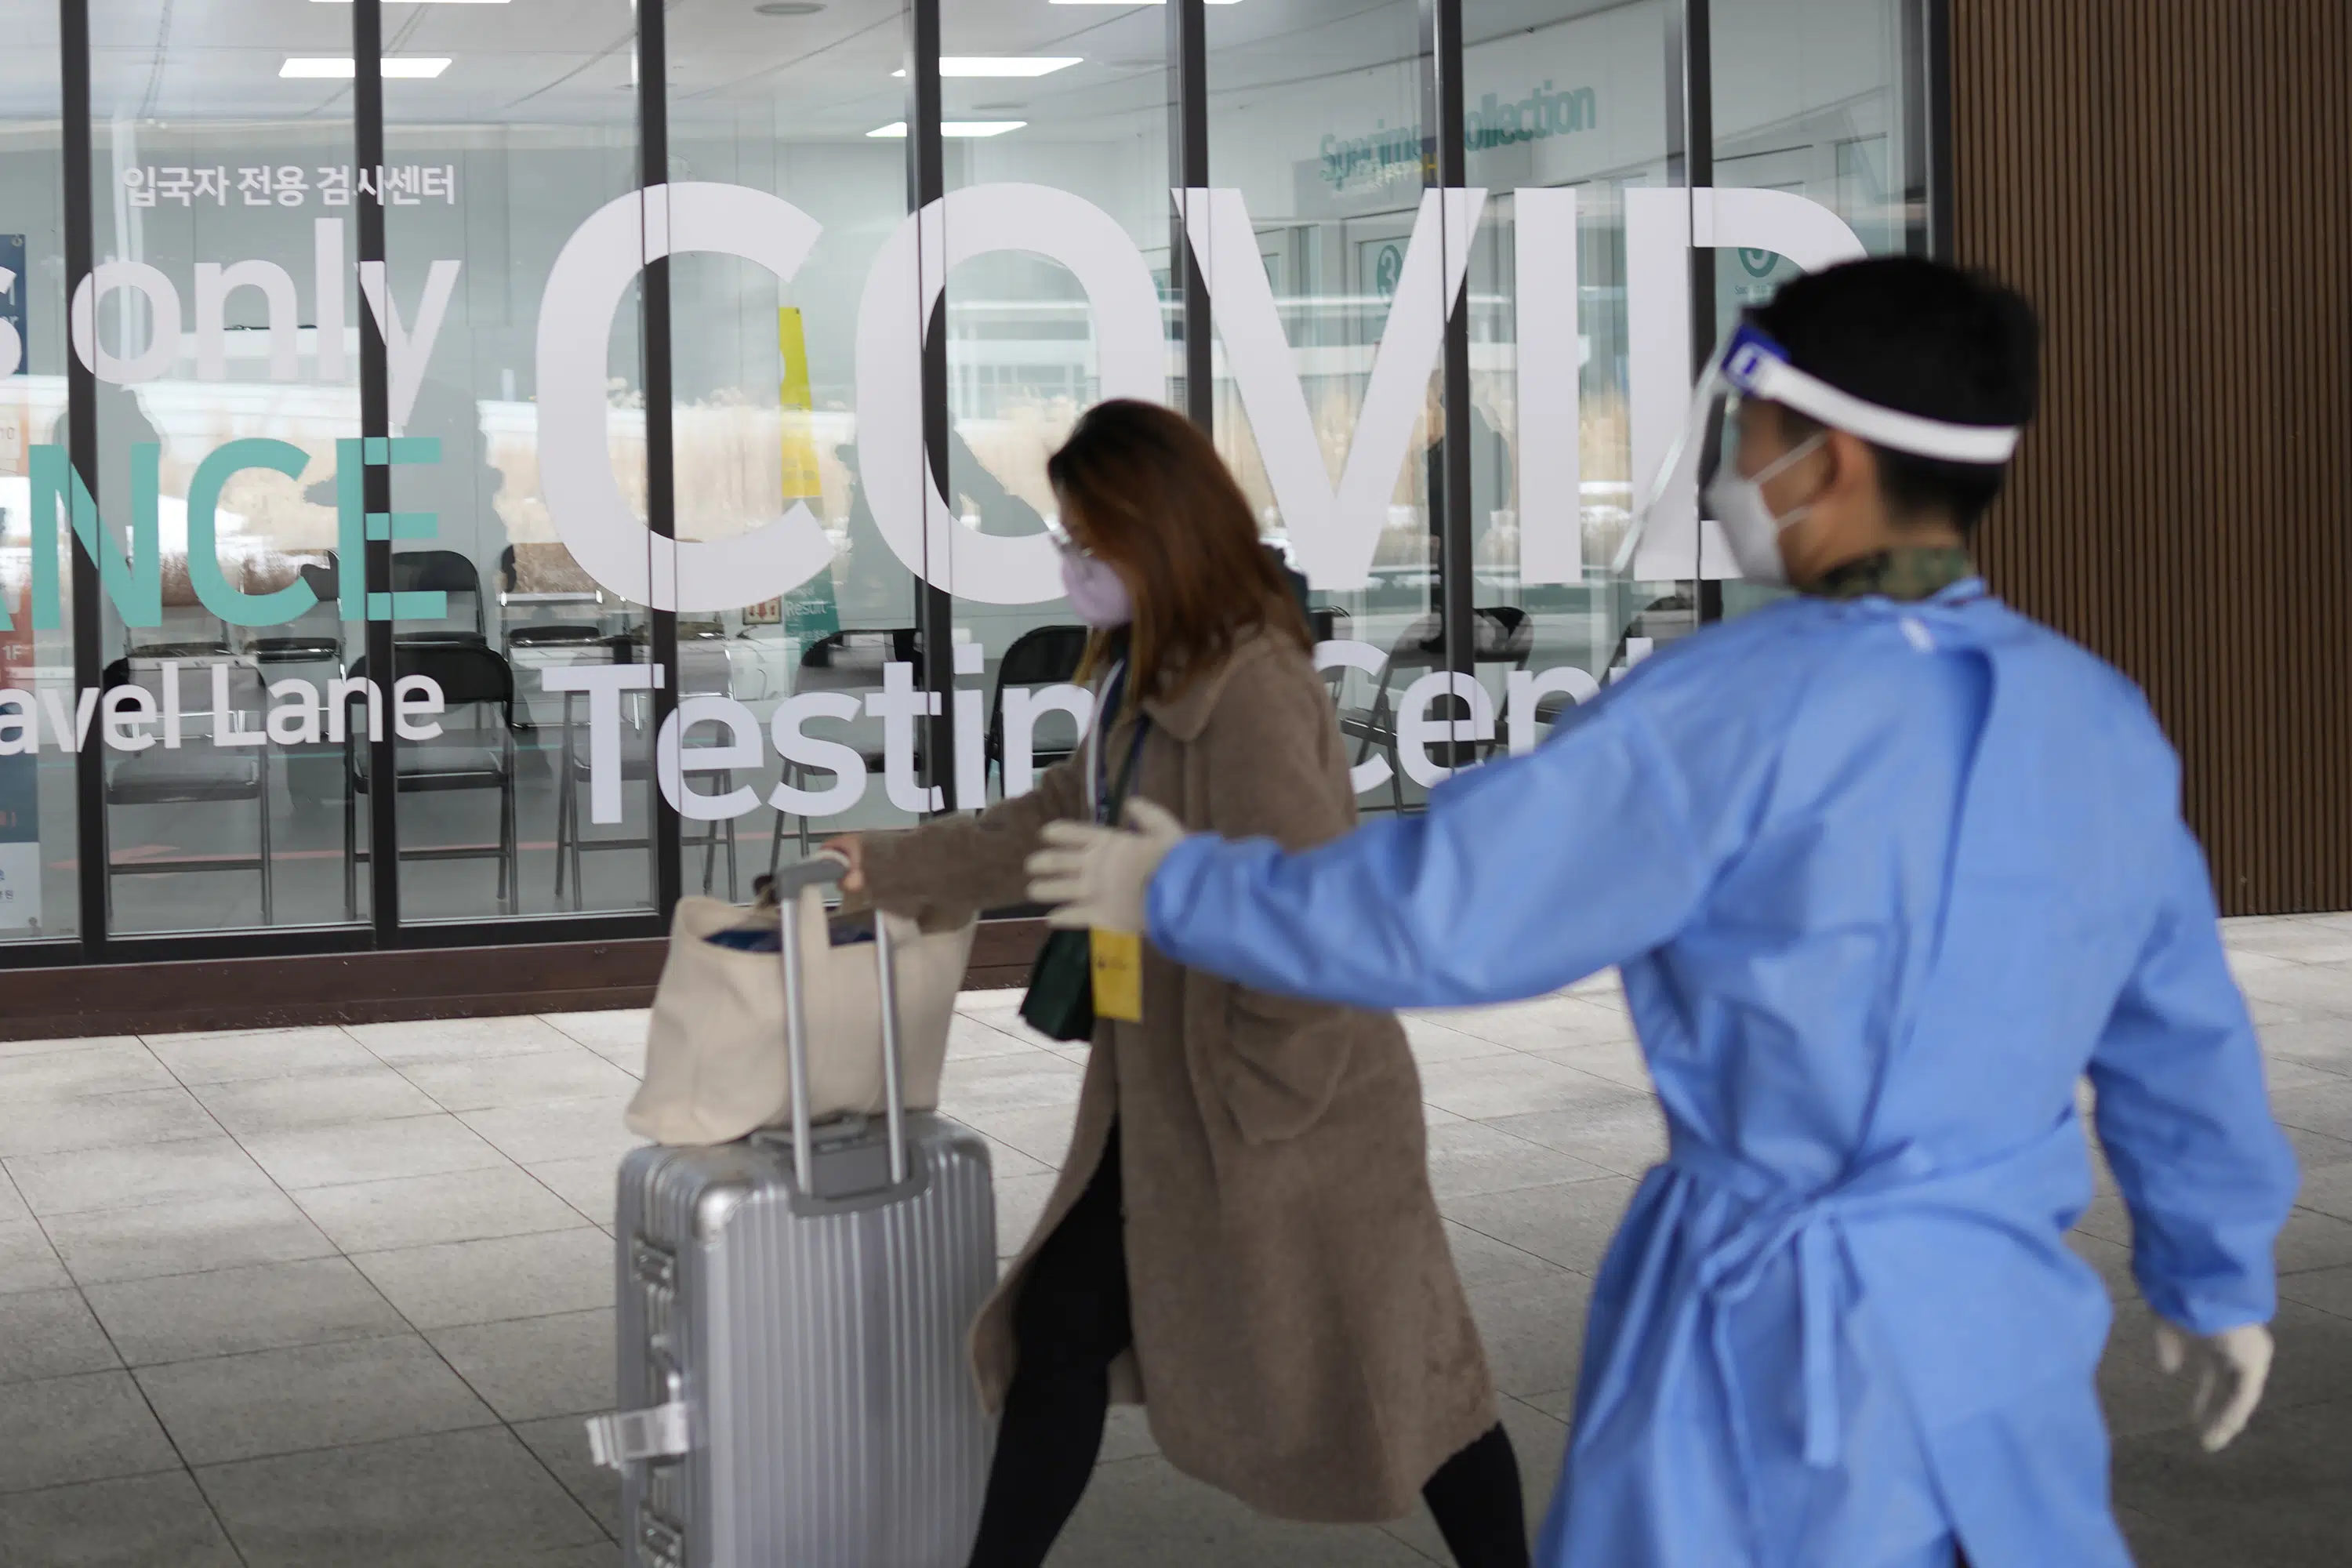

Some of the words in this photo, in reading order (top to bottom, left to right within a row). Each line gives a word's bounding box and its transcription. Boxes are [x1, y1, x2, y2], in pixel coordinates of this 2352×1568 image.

[122, 165, 230, 208] 입국자
[237, 165, 310, 207] 전용
[315, 164, 455, 206] 검사센터
[1319, 118, 1422, 191] Specime
[1464, 79, 1596, 152] ollection
[71, 217, 462, 427] only
[0, 437, 448, 631] NCE
[212, 662, 445, 747] Lane
[541, 643, 1097, 824] Testin
